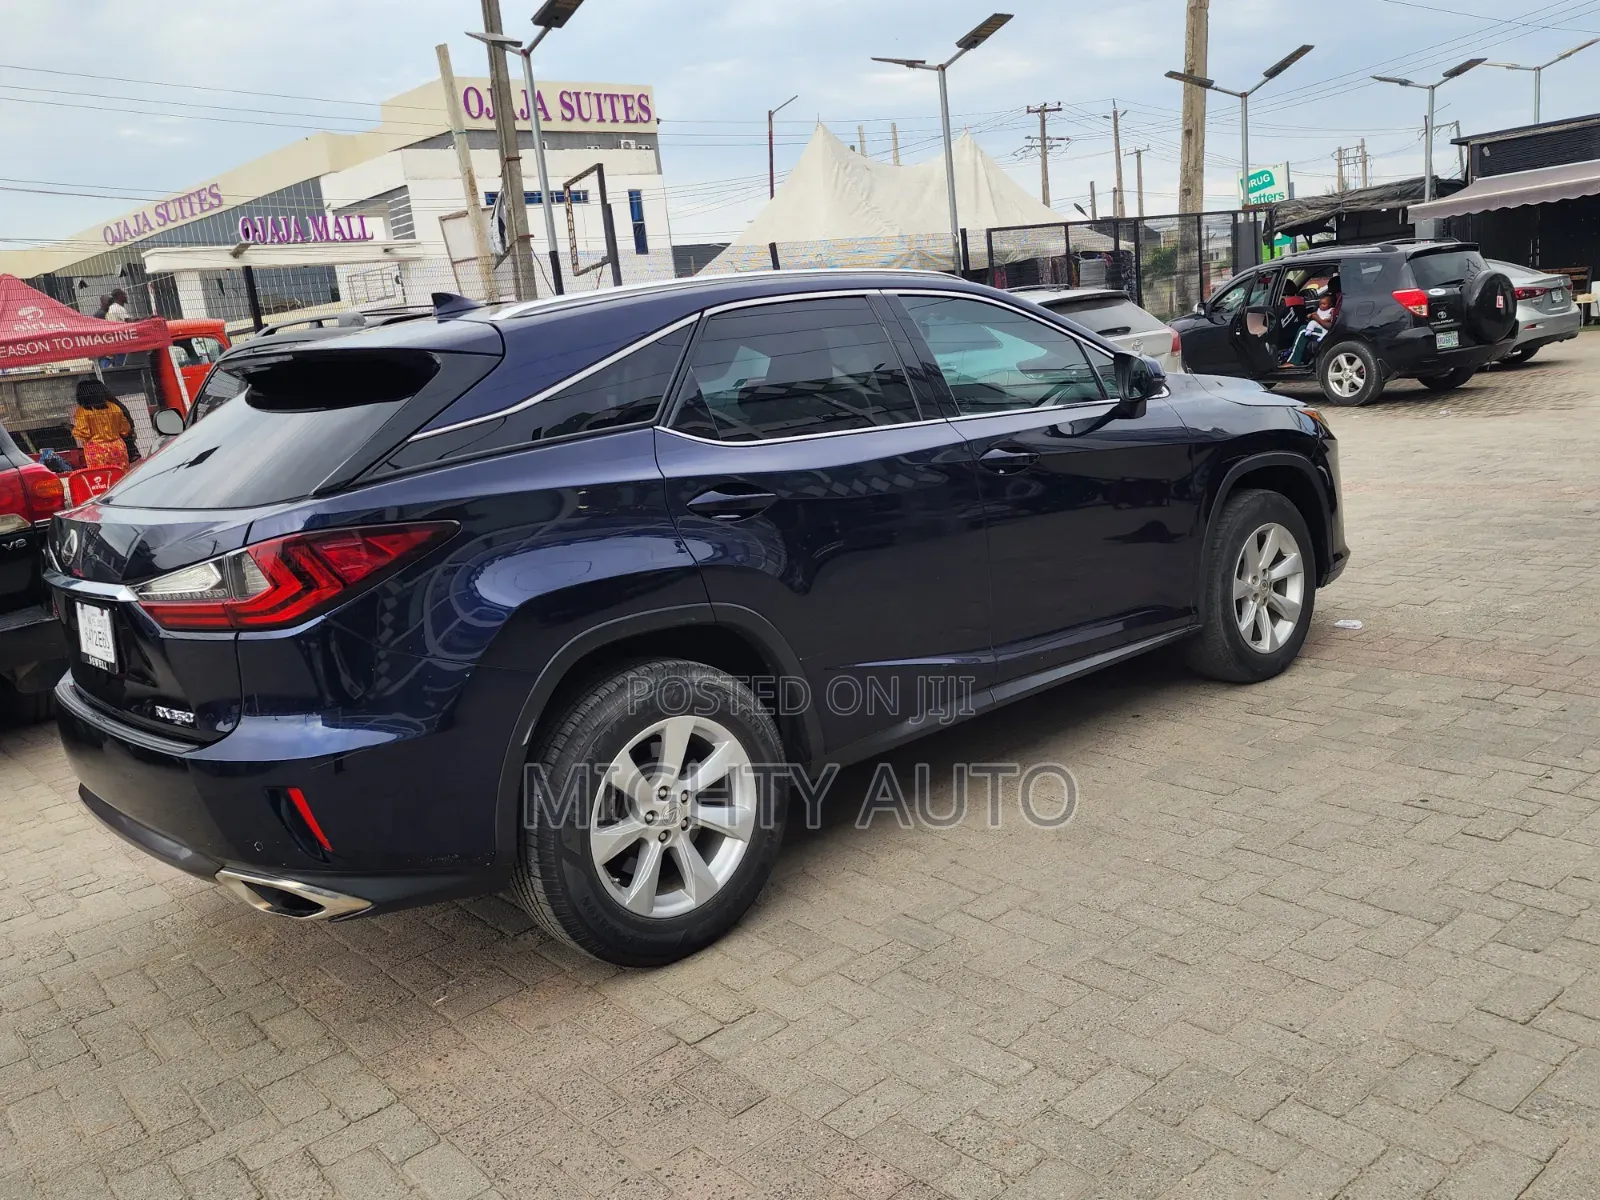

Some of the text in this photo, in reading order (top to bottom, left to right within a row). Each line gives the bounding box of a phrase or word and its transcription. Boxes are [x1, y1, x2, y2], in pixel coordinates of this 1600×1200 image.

[463, 86, 651, 124] OJJA SUITES
[1248, 173, 1271, 189] RUG
[103, 182, 223, 246] OJAJA SUITES
[239, 215, 374, 244] OJAJA MALL
[52, 337, 73, 350] TO
[75, 328, 139, 348] IMAGINE
